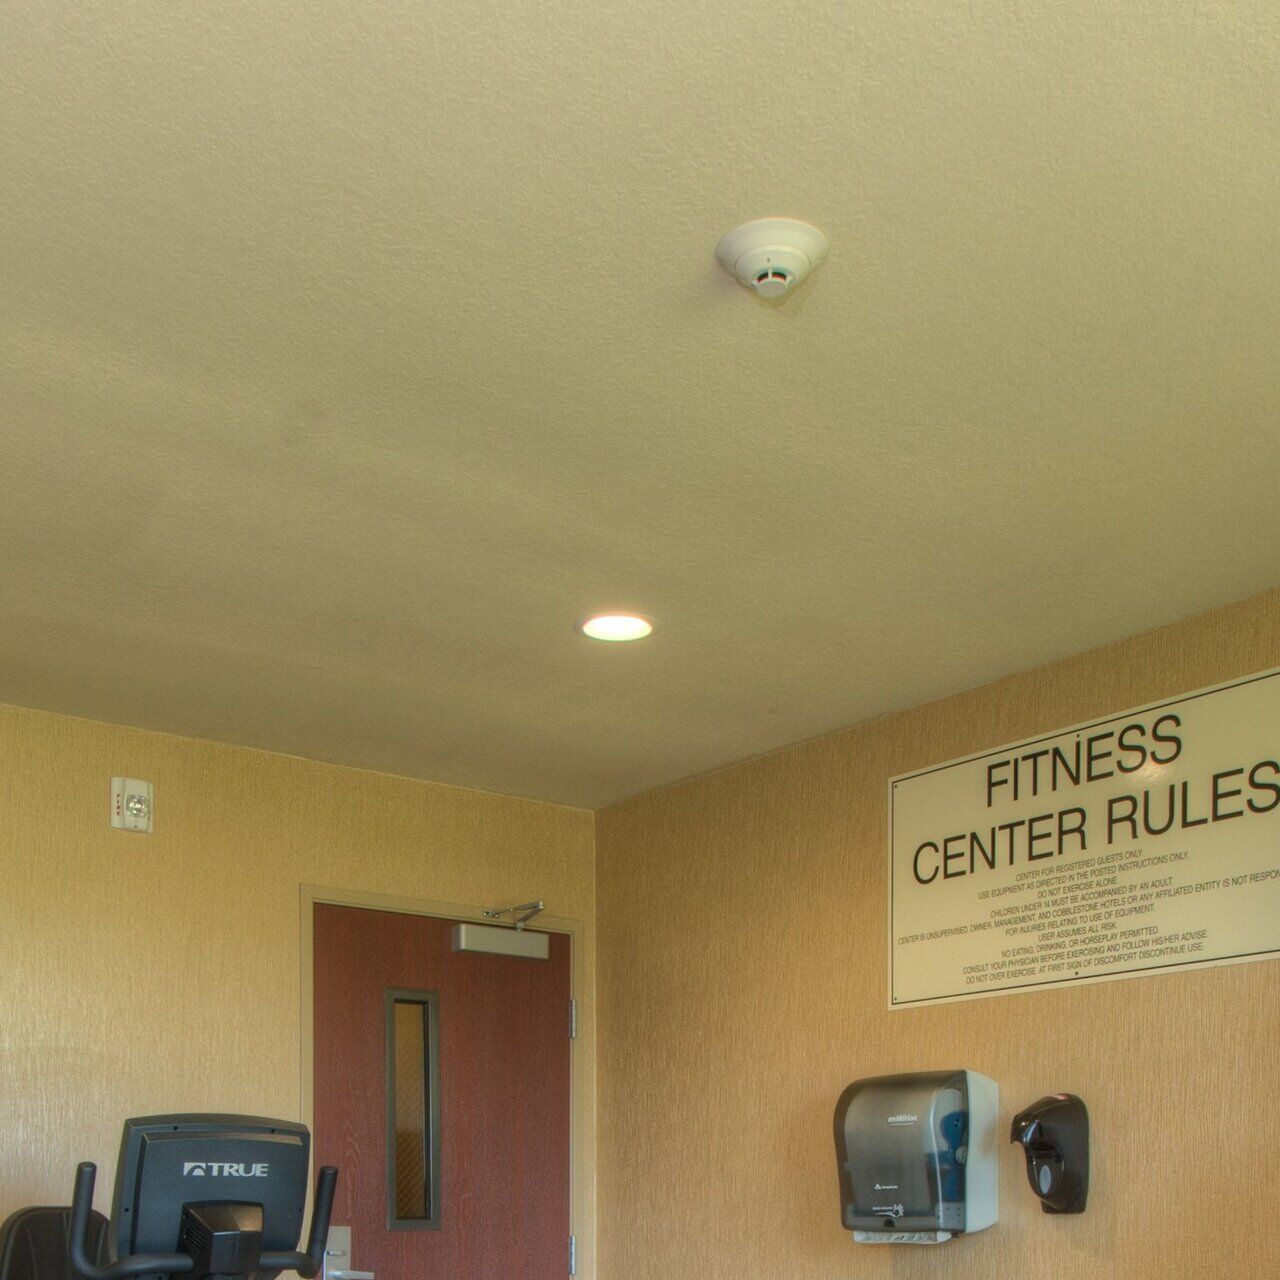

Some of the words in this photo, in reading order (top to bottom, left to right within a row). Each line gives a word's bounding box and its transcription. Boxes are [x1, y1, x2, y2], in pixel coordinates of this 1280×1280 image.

[987, 714, 1181, 807] FITNESS
[913, 807, 1087, 885] CENTER
[978, 889, 990, 900] USE
[991, 882, 1024, 897] EQUIPMENT
[1026, 881, 1034, 890] AS
[1035, 874, 1066, 889] DIRECTED
[1068, 873, 1075, 882] IN
[1076, 870, 1088, 881] THE
[1089, 865, 1116, 878] POSTED
[1117, 855, 1168, 873] INSTRUCTIONS
[1015, 869, 1039, 882] CENTER
[1041, 866, 1054, 877] FOR
[1055, 858, 1095, 874] REGISTERED
[1096, 853, 1123, 866] GUESTS
[990, 904, 1019, 918] CHILDREN
[1020, 900, 1042, 913] UNDER
[1043, 899, 1050, 908] 14
[1050, 895, 1069, 907] MUST
[1070, 894, 1078, 904] BE
[1080, 885, 1127, 902] ACCOMPANIED
[1128, 883, 1138, 893] BY
[1138, 881, 1149, 891] AN
[1037, 888, 1047, 899] DO
[1048, 886, 1061, 897] NOT
[1062, 880, 1093, 894] EXERCISE
[897, 933, 919, 945] CENTER
[919, 932, 925, 941] IS
[1038, 910, 1050, 920] AND
[1051, 901, 1099, 918] COBBLESTONE
[1100, 897, 1126, 909] HOTELS
[1127, 895, 1137, 905] OR
[1138, 892, 1153, 903] ANY
[1155, 885, 1193, 900] AFFILIATED
[1194, 880, 1220, 893] ENTITY
[1222, 878, 1230, 888] IS
[1231, 875, 1247, 886] NOT
[1005, 925, 1018, 936] FOR
[1019, 921, 1046, 934] INJURIES
[1047, 916, 1077, 929] RELATING
[1078, 914, 1088, 924] TO
[1089, 912, 1102, 922] USE
[1103, 910, 1113, 920] OF
[1001, 948, 1011, 958] NO
[1068, 938, 1079, 948] OR
[1079, 932, 1118, 946] HORSEPLAY
[1037, 931, 1055, 942] USER
[1056, 926, 1086, 939] ASSUMES
[1088, 924, 1099, 934] ALL
[962, 962, 989, 975] CONSULT
[990, 960, 1006, 970] YOUR
[1007, 955, 1038, 968] PHYSICIAN
[1040, 951, 1065, 963] BEFORE
[1066, 945, 1104, 959] EXERCISING
[1106, 943, 1120, 953] AND
[1121, 938, 1150, 951] FOLLOW
[965, 975, 975, 985] DO
[976, 973, 987, 983] NOT
[989, 971, 1005, 981] OVER
[1038, 965, 1045, 974] AT
[1047, 962, 1064, 973] FIRST
[1066, 960, 1081, 970] SIGN
[1082, 958, 1092, 968] OF
[1093, 952, 1136, 966] DISCOMFORT
[1138, 945, 1185, 960] DISCONTINUE
[207, 1162, 269, 1177] TRUE
